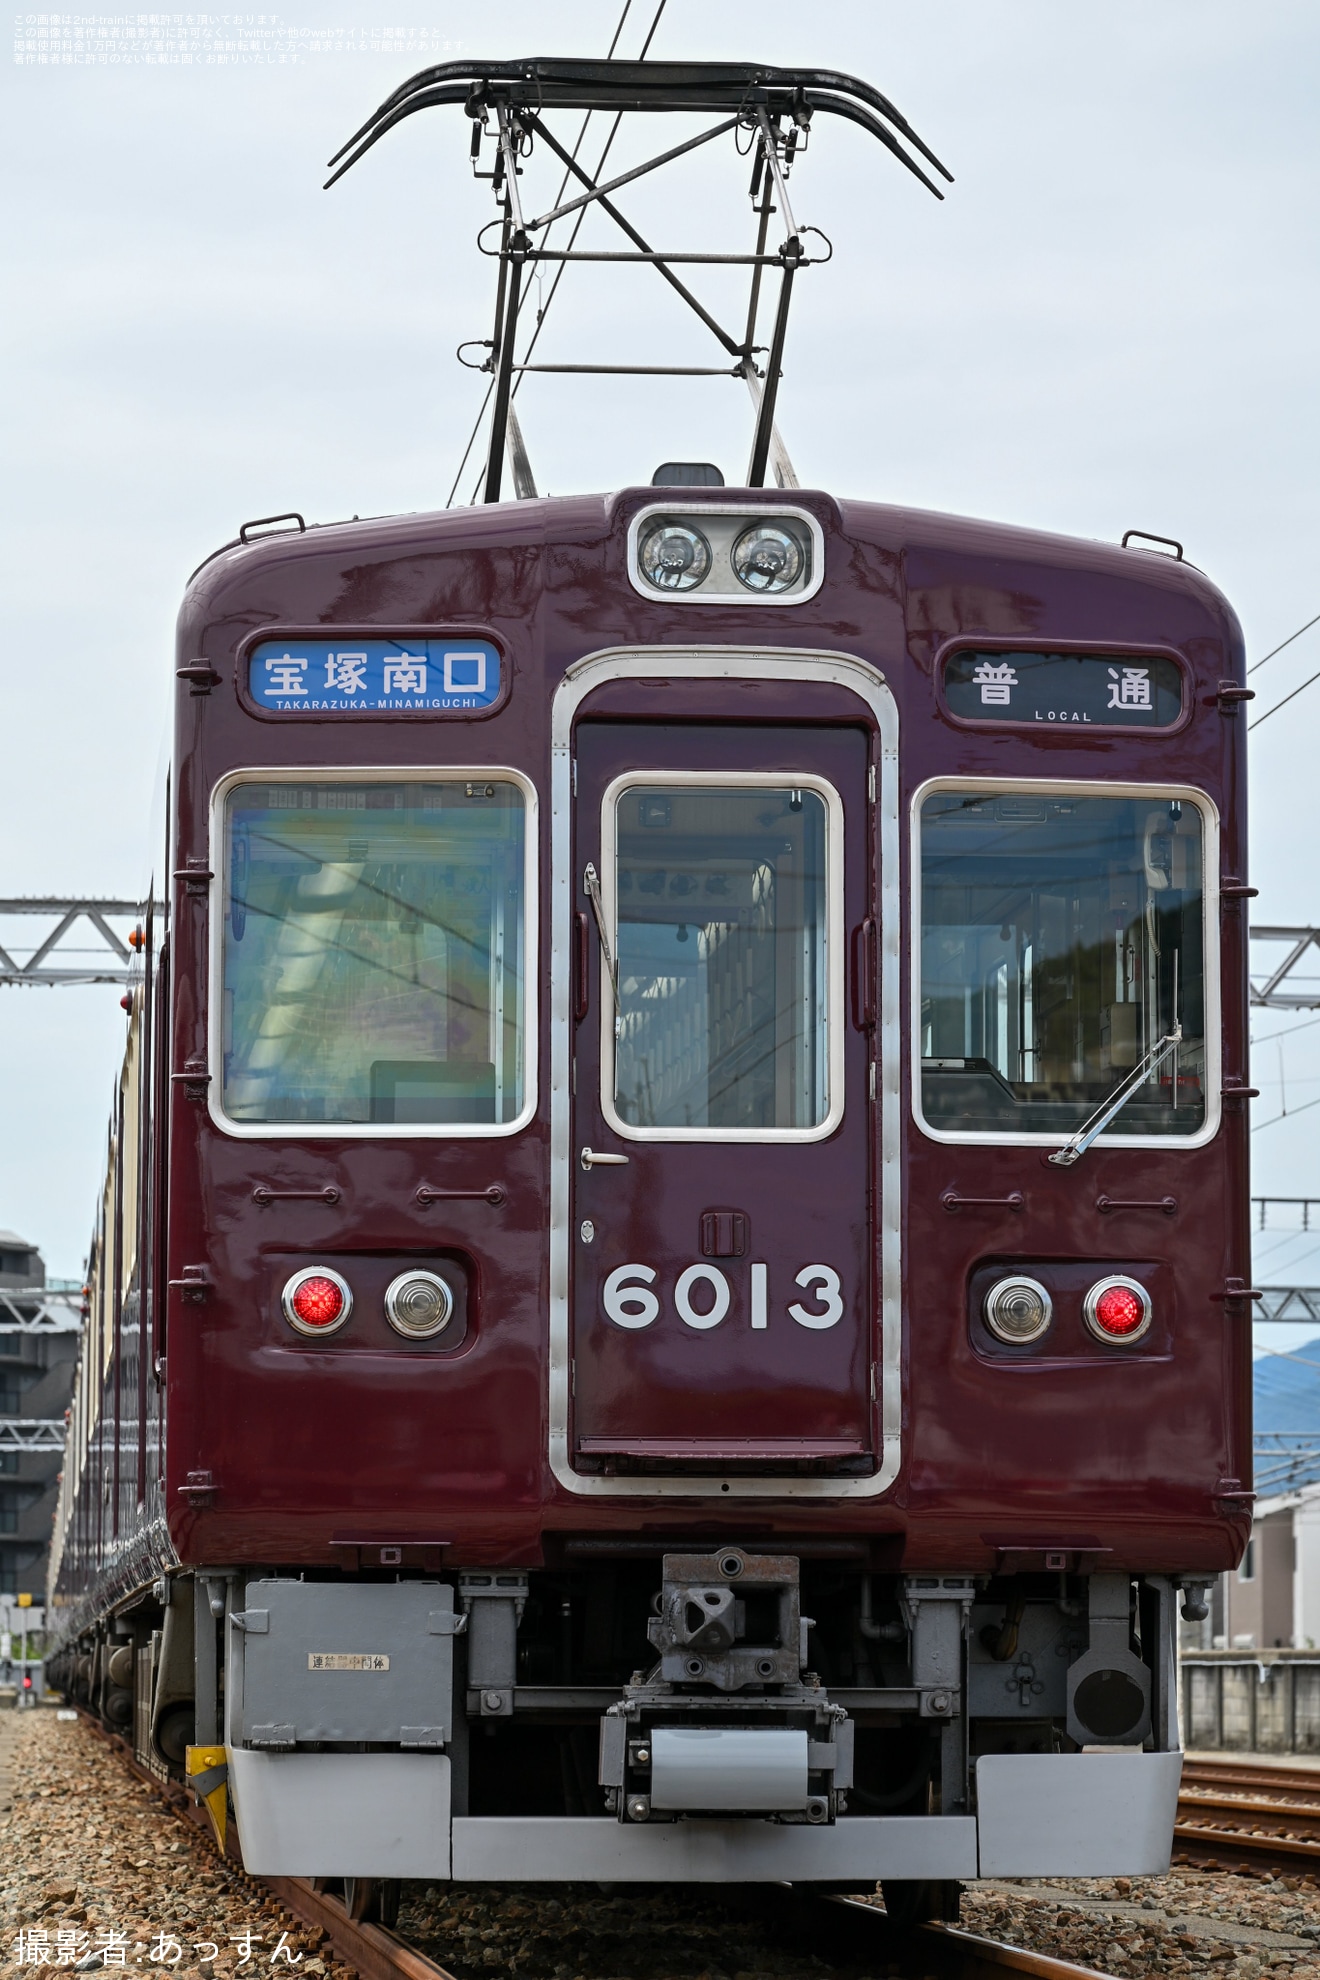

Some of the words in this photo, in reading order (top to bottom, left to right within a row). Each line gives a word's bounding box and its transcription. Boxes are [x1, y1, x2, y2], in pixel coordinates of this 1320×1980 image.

[264, 652, 487, 696] 宝塚南口
[972, 661, 1153, 710] 普通
[276, 698, 477, 710] TAKARAZUKA-MINAMIGUCHI
[1035, 710, 1092, 722] LOCAL
[603, 1263, 843, 1329] 6013
